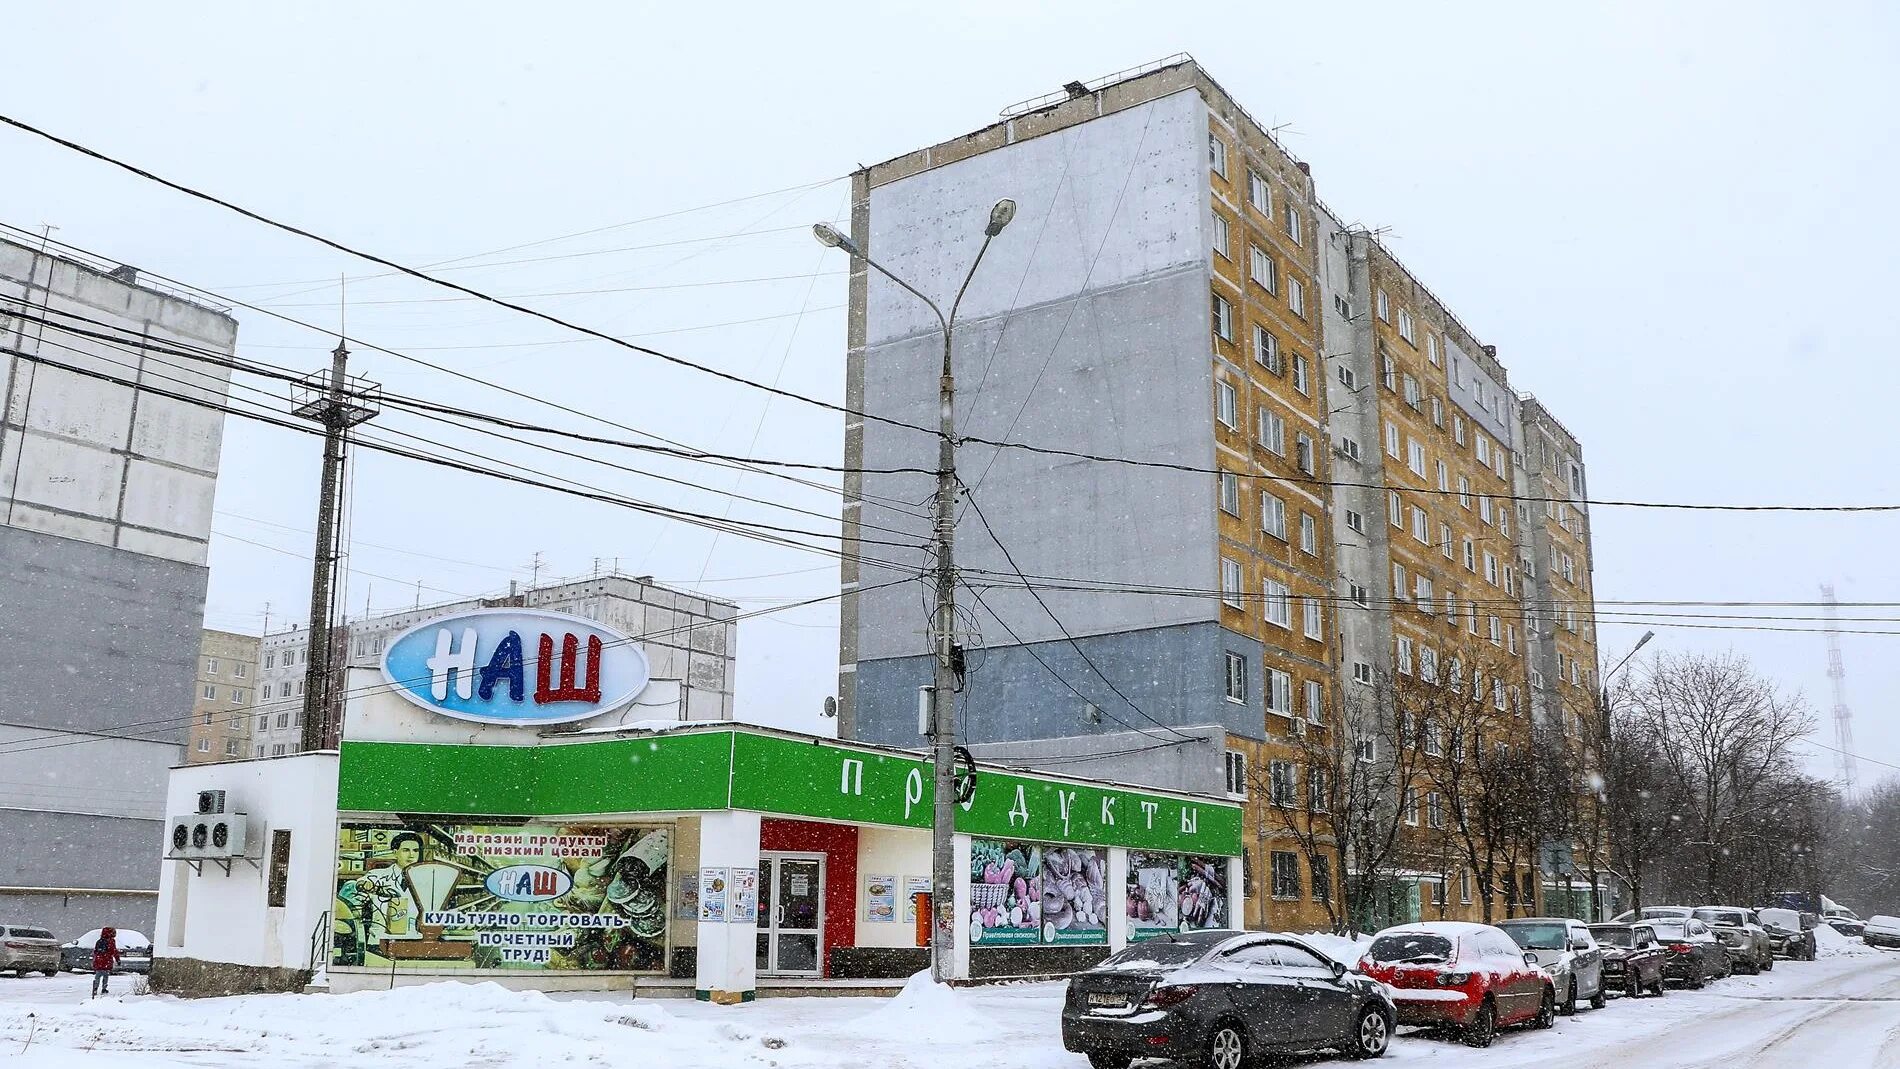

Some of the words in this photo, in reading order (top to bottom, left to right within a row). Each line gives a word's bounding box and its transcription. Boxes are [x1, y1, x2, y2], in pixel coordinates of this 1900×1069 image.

[426, 627, 602, 704] НАШ
[454, 833, 523, 845] магазин
[530, 835, 607, 848] продукты
[458, 845, 477, 855] по
[484, 846, 544, 856] низким
[551, 847, 603, 858] ценам
[498, 870, 558, 896] НАШ
[425, 913, 520, 926] КУЛЬТУРНО
[480, 933, 573, 946] ПОЧЕТНЫЙ
[502, 949, 549, 962] ТРУД!
